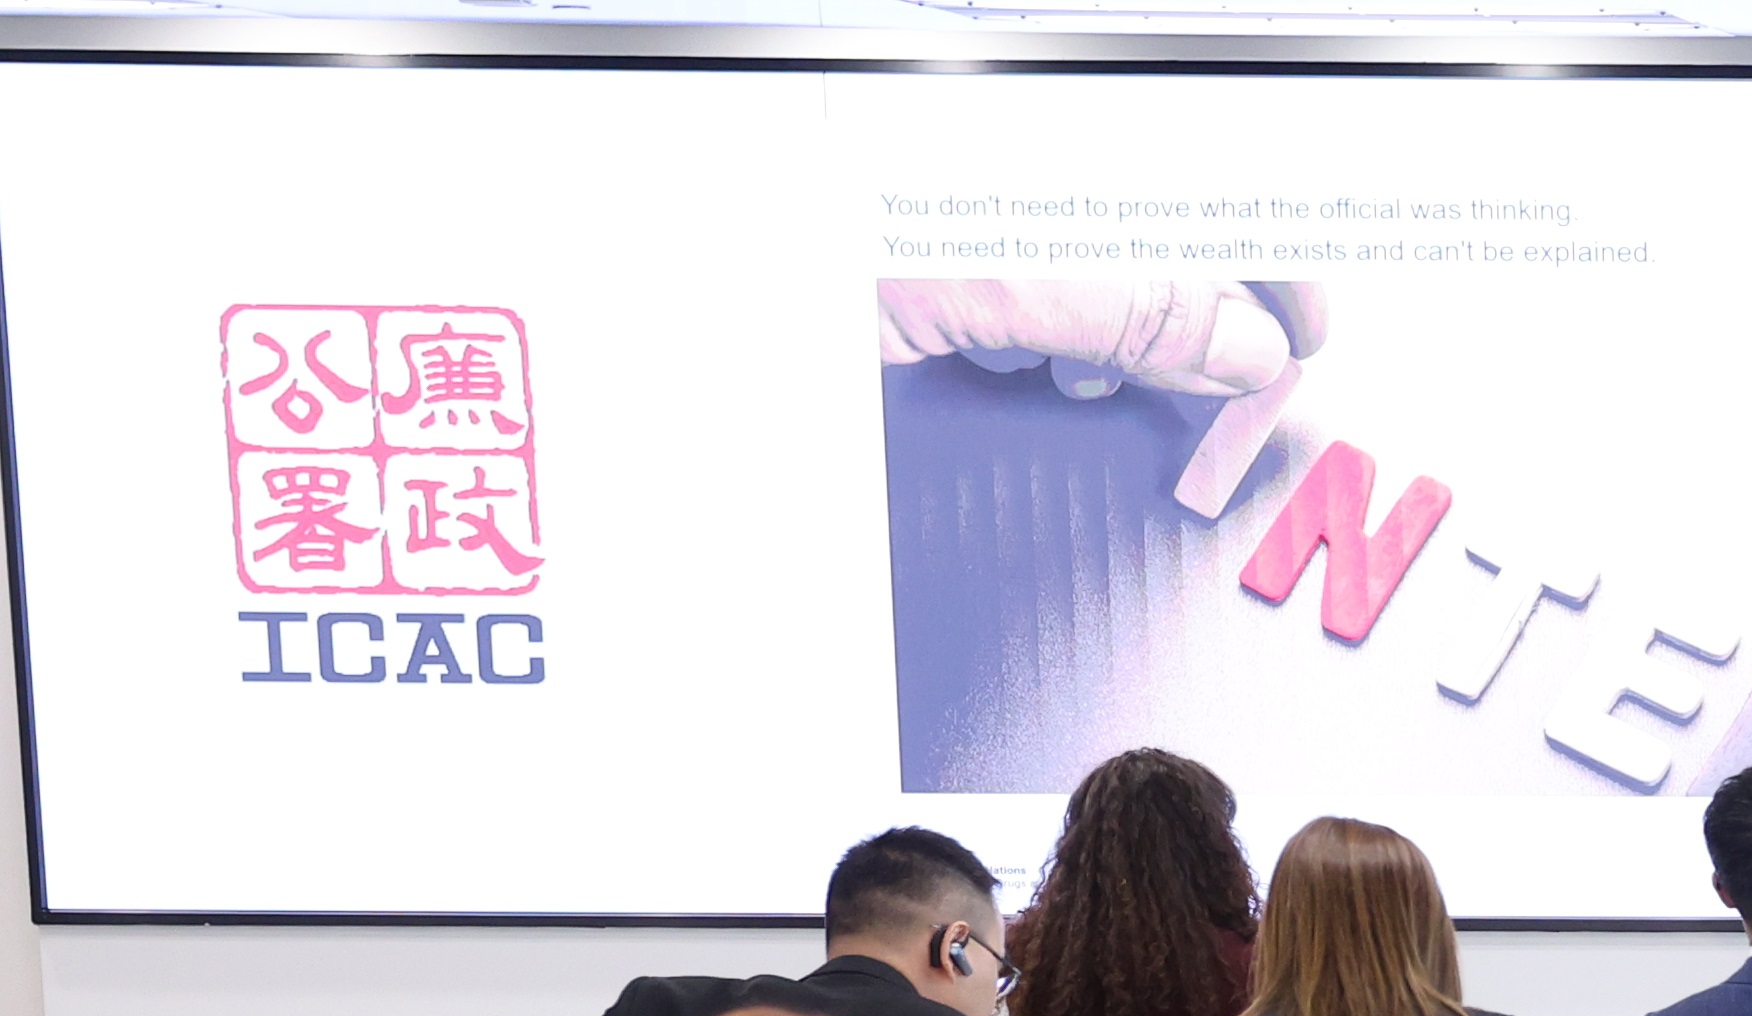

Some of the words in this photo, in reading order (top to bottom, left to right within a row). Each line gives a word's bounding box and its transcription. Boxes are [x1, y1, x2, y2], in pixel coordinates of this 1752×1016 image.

[881, 195, 928, 214] You
[940, 196, 1000, 215] don't
[1012, 197, 1074, 216] need
[1086, 197, 1107, 216] to
[1119, 202, 1189, 222] prove
[1200, 198, 1260, 217] what
[1271, 199, 1308, 218] the
[1320, 198, 1399, 218] official
[1411, 204, 1460, 219] was
[1472, 200, 1577, 226] thinking.
[883, 236, 930, 256] You
[943, 237, 1004, 257] need
[1016, 238, 1038, 257] to
[1050, 243, 1120, 263] prove
[1131, 239, 1168, 258] the
[1180, 240, 1262, 259] wealth
[1274, 241, 1346, 260] exists
[1357, 241, 1402, 260] and
[1415, 241, 1472, 260] can't
[1484, 242, 1513, 261] be
[1525, 242, 1654, 267] explained.
[238, 612, 546, 684] ICAC
[989, 866, 1026, 875] ations
